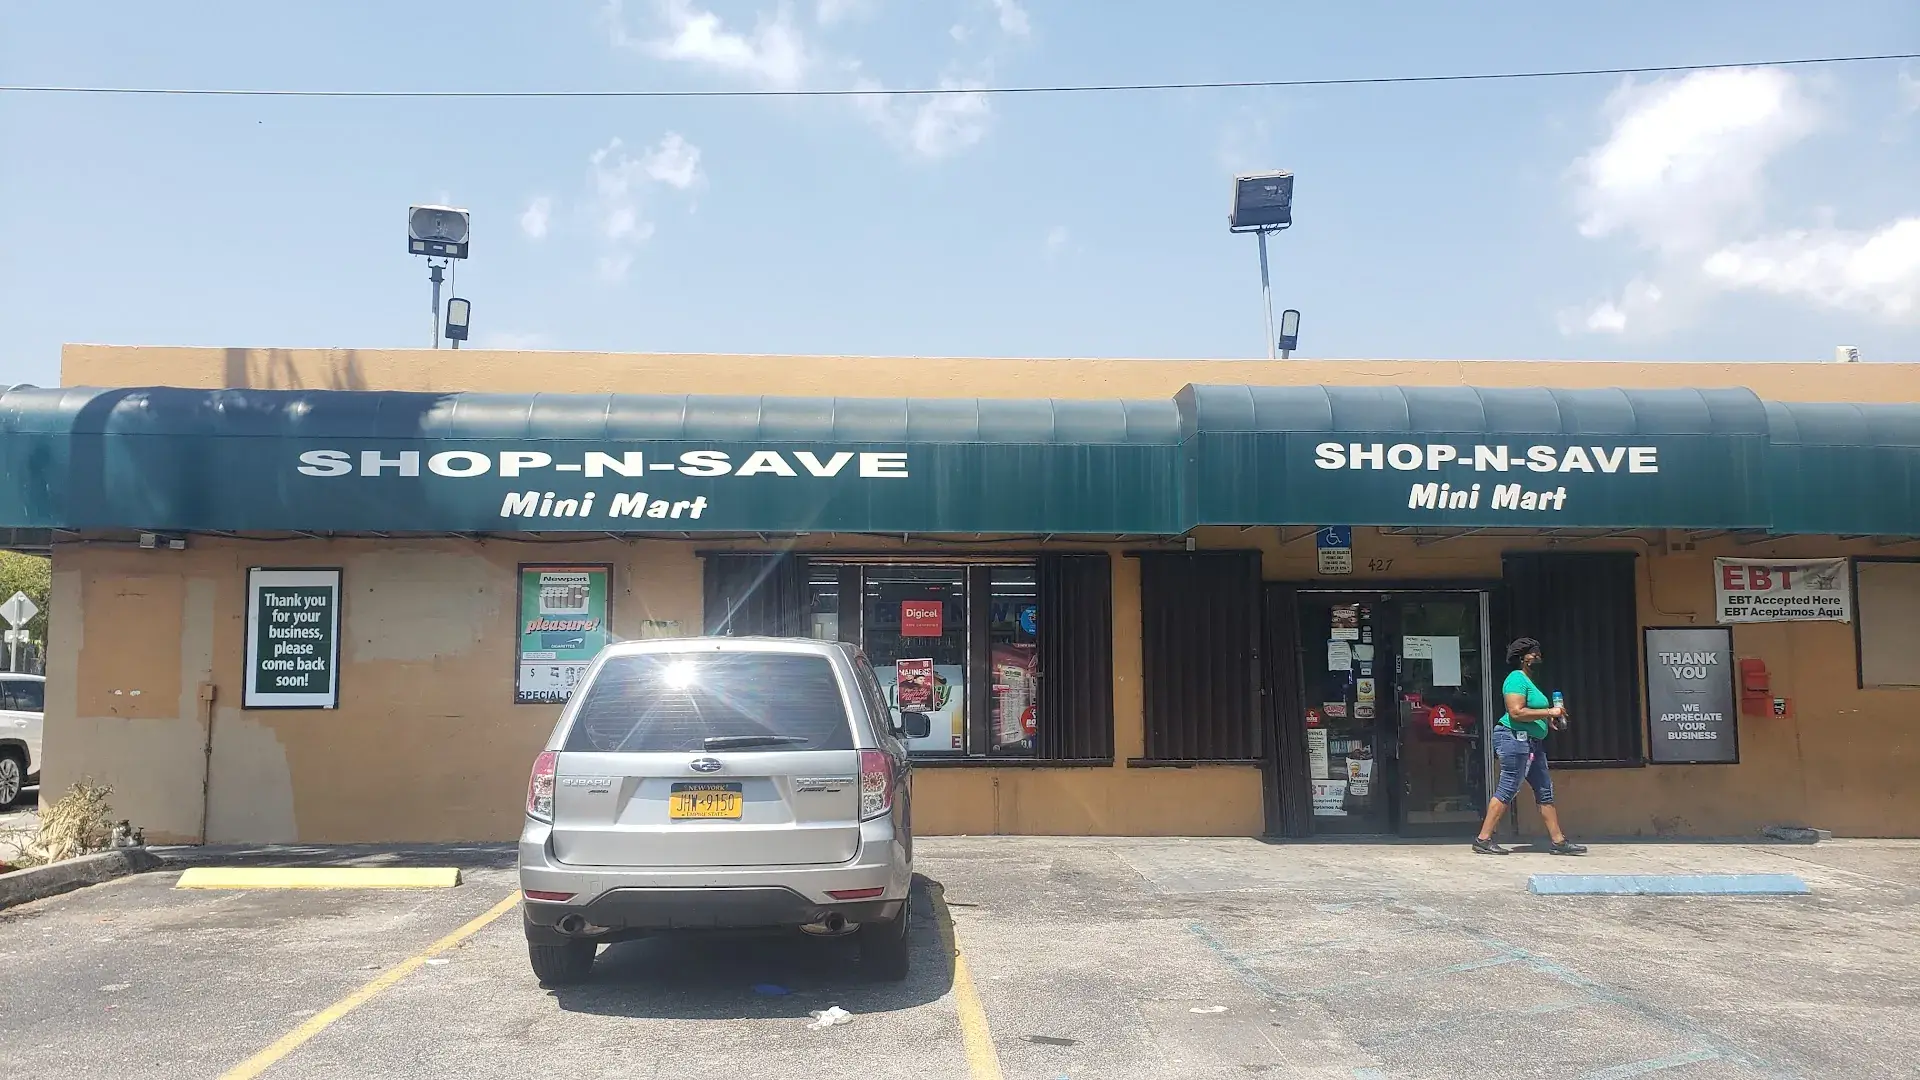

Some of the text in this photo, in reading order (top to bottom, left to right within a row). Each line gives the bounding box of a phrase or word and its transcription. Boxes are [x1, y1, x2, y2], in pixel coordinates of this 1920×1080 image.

[297, 450, 909, 478] SHOP-N-SAVE
[1314, 443, 1659, 473] SHOP-N-SAVE
[1408, 482, 1567, 510] Mini Mart
[500, 490, 708, 519] Mini Mart
[1368, 558, 1394, 571] 427
[1722, 566, 1797, 590] EBT
[264, 593, 326, 610] Thank you
[1728, 595, 1841, 606] EBT Accepted Here
[272, 609, 321, 626] for your
[906, 609, 938, 619] Digicel
[1724, 607, 1843, 618] EBT Aceptamos Aqui
[525, 616, 601, 635] pleasure!
[268, 625, 324, 640] business,
[274, 641, 314, 658] please
[261, 657, 326, 671] come back
[1659, 652, 1718, 665] THANK
[530, 668, 535, 678] $
[1671, 666, 1707, 679] YOU
[275, 673, 309, 687] soon!
[518, 690, 563, 700] SPECIAL
[1682, 703, 1700, 712] WE
[1660, 713, 1722, 721] APPRECIATE
[1677, 722, 1706, 731] YOUR
[1667, 732, 1717, 740] BUSINESS
